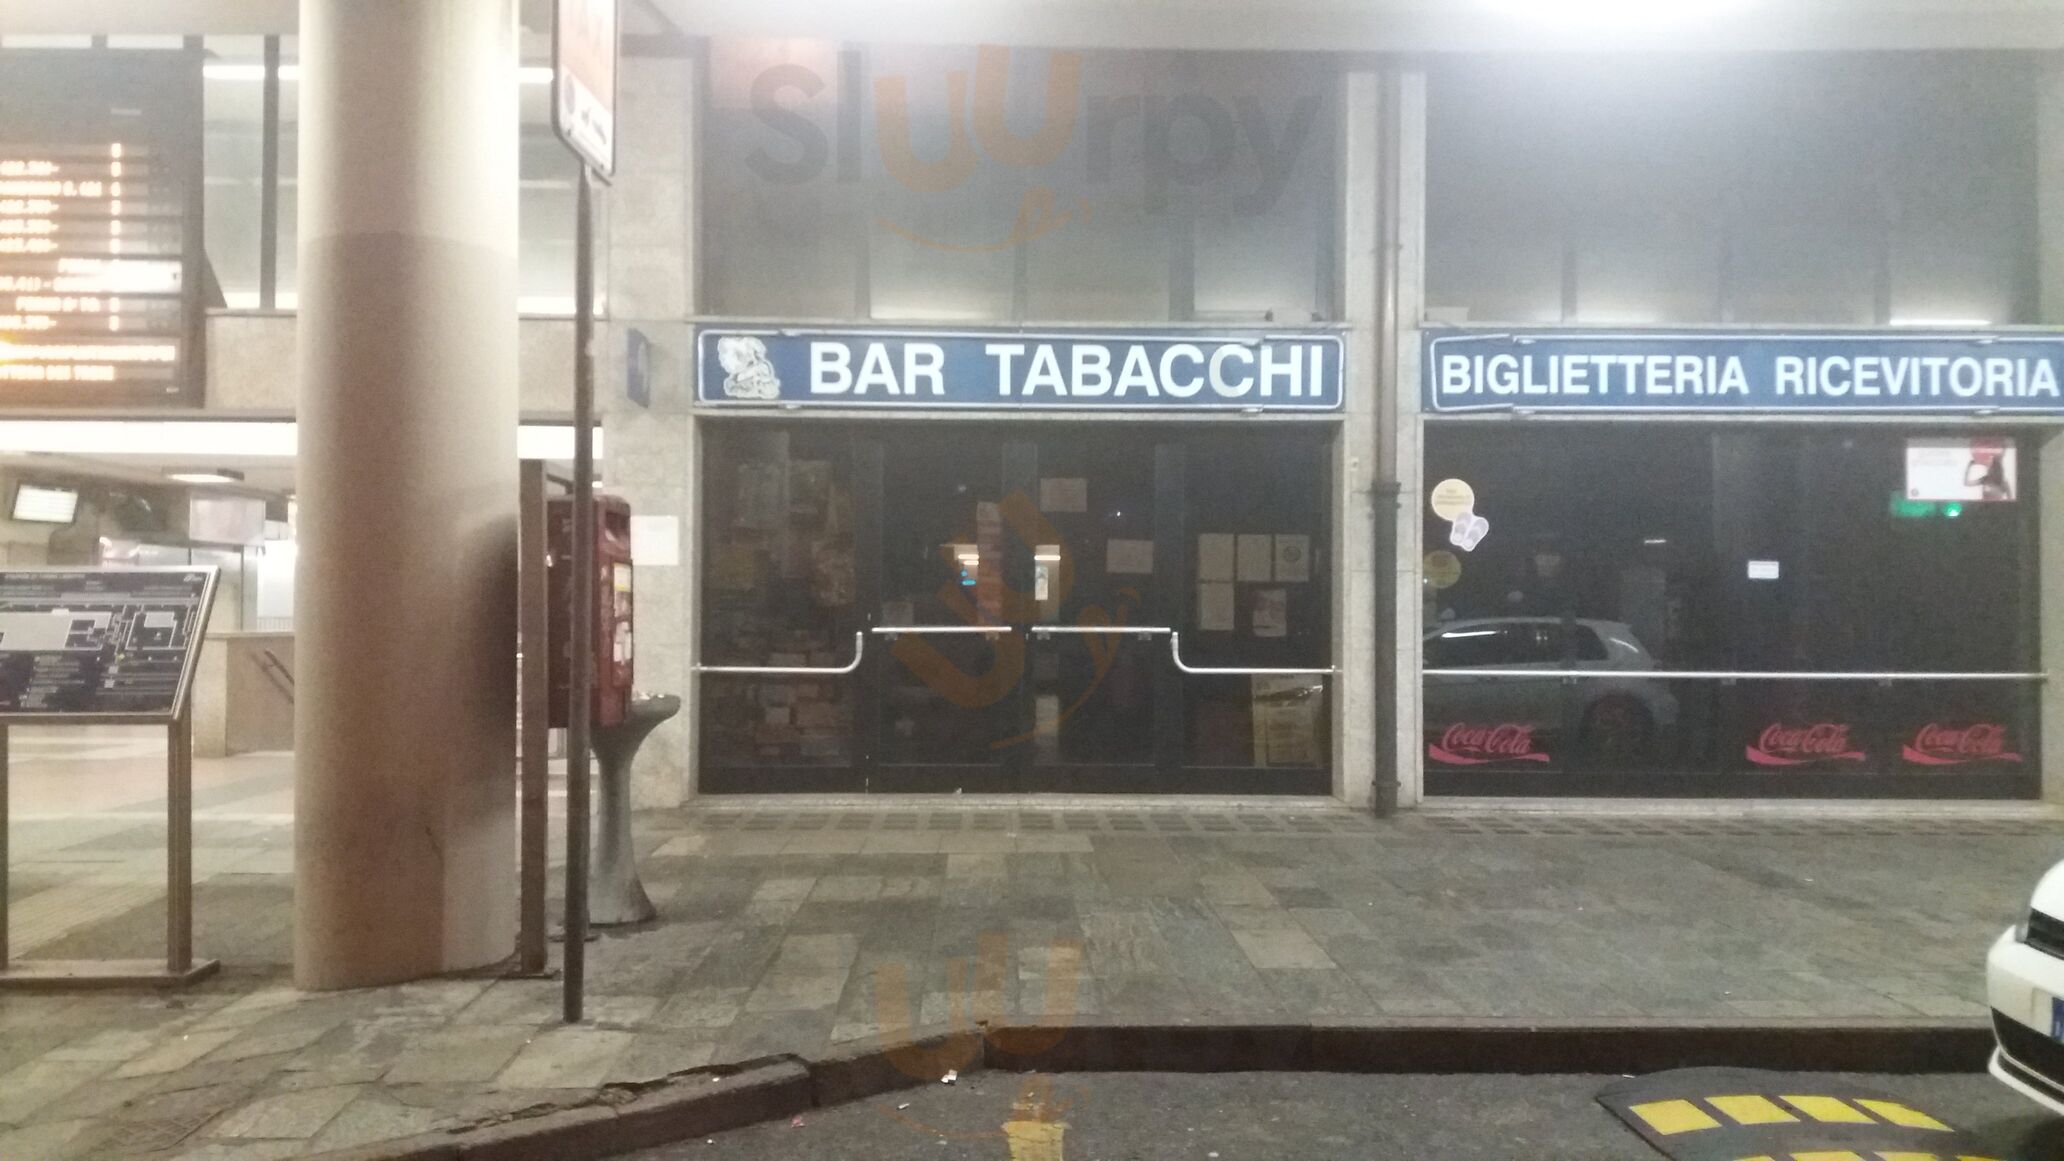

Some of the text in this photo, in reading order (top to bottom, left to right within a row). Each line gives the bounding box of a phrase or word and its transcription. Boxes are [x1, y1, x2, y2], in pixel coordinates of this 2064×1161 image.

[810, 342, 1323, 397] BAR TABACCHI
[1442, 353, 2061, 397] BIGLIETTERIA RICEVITORIA
